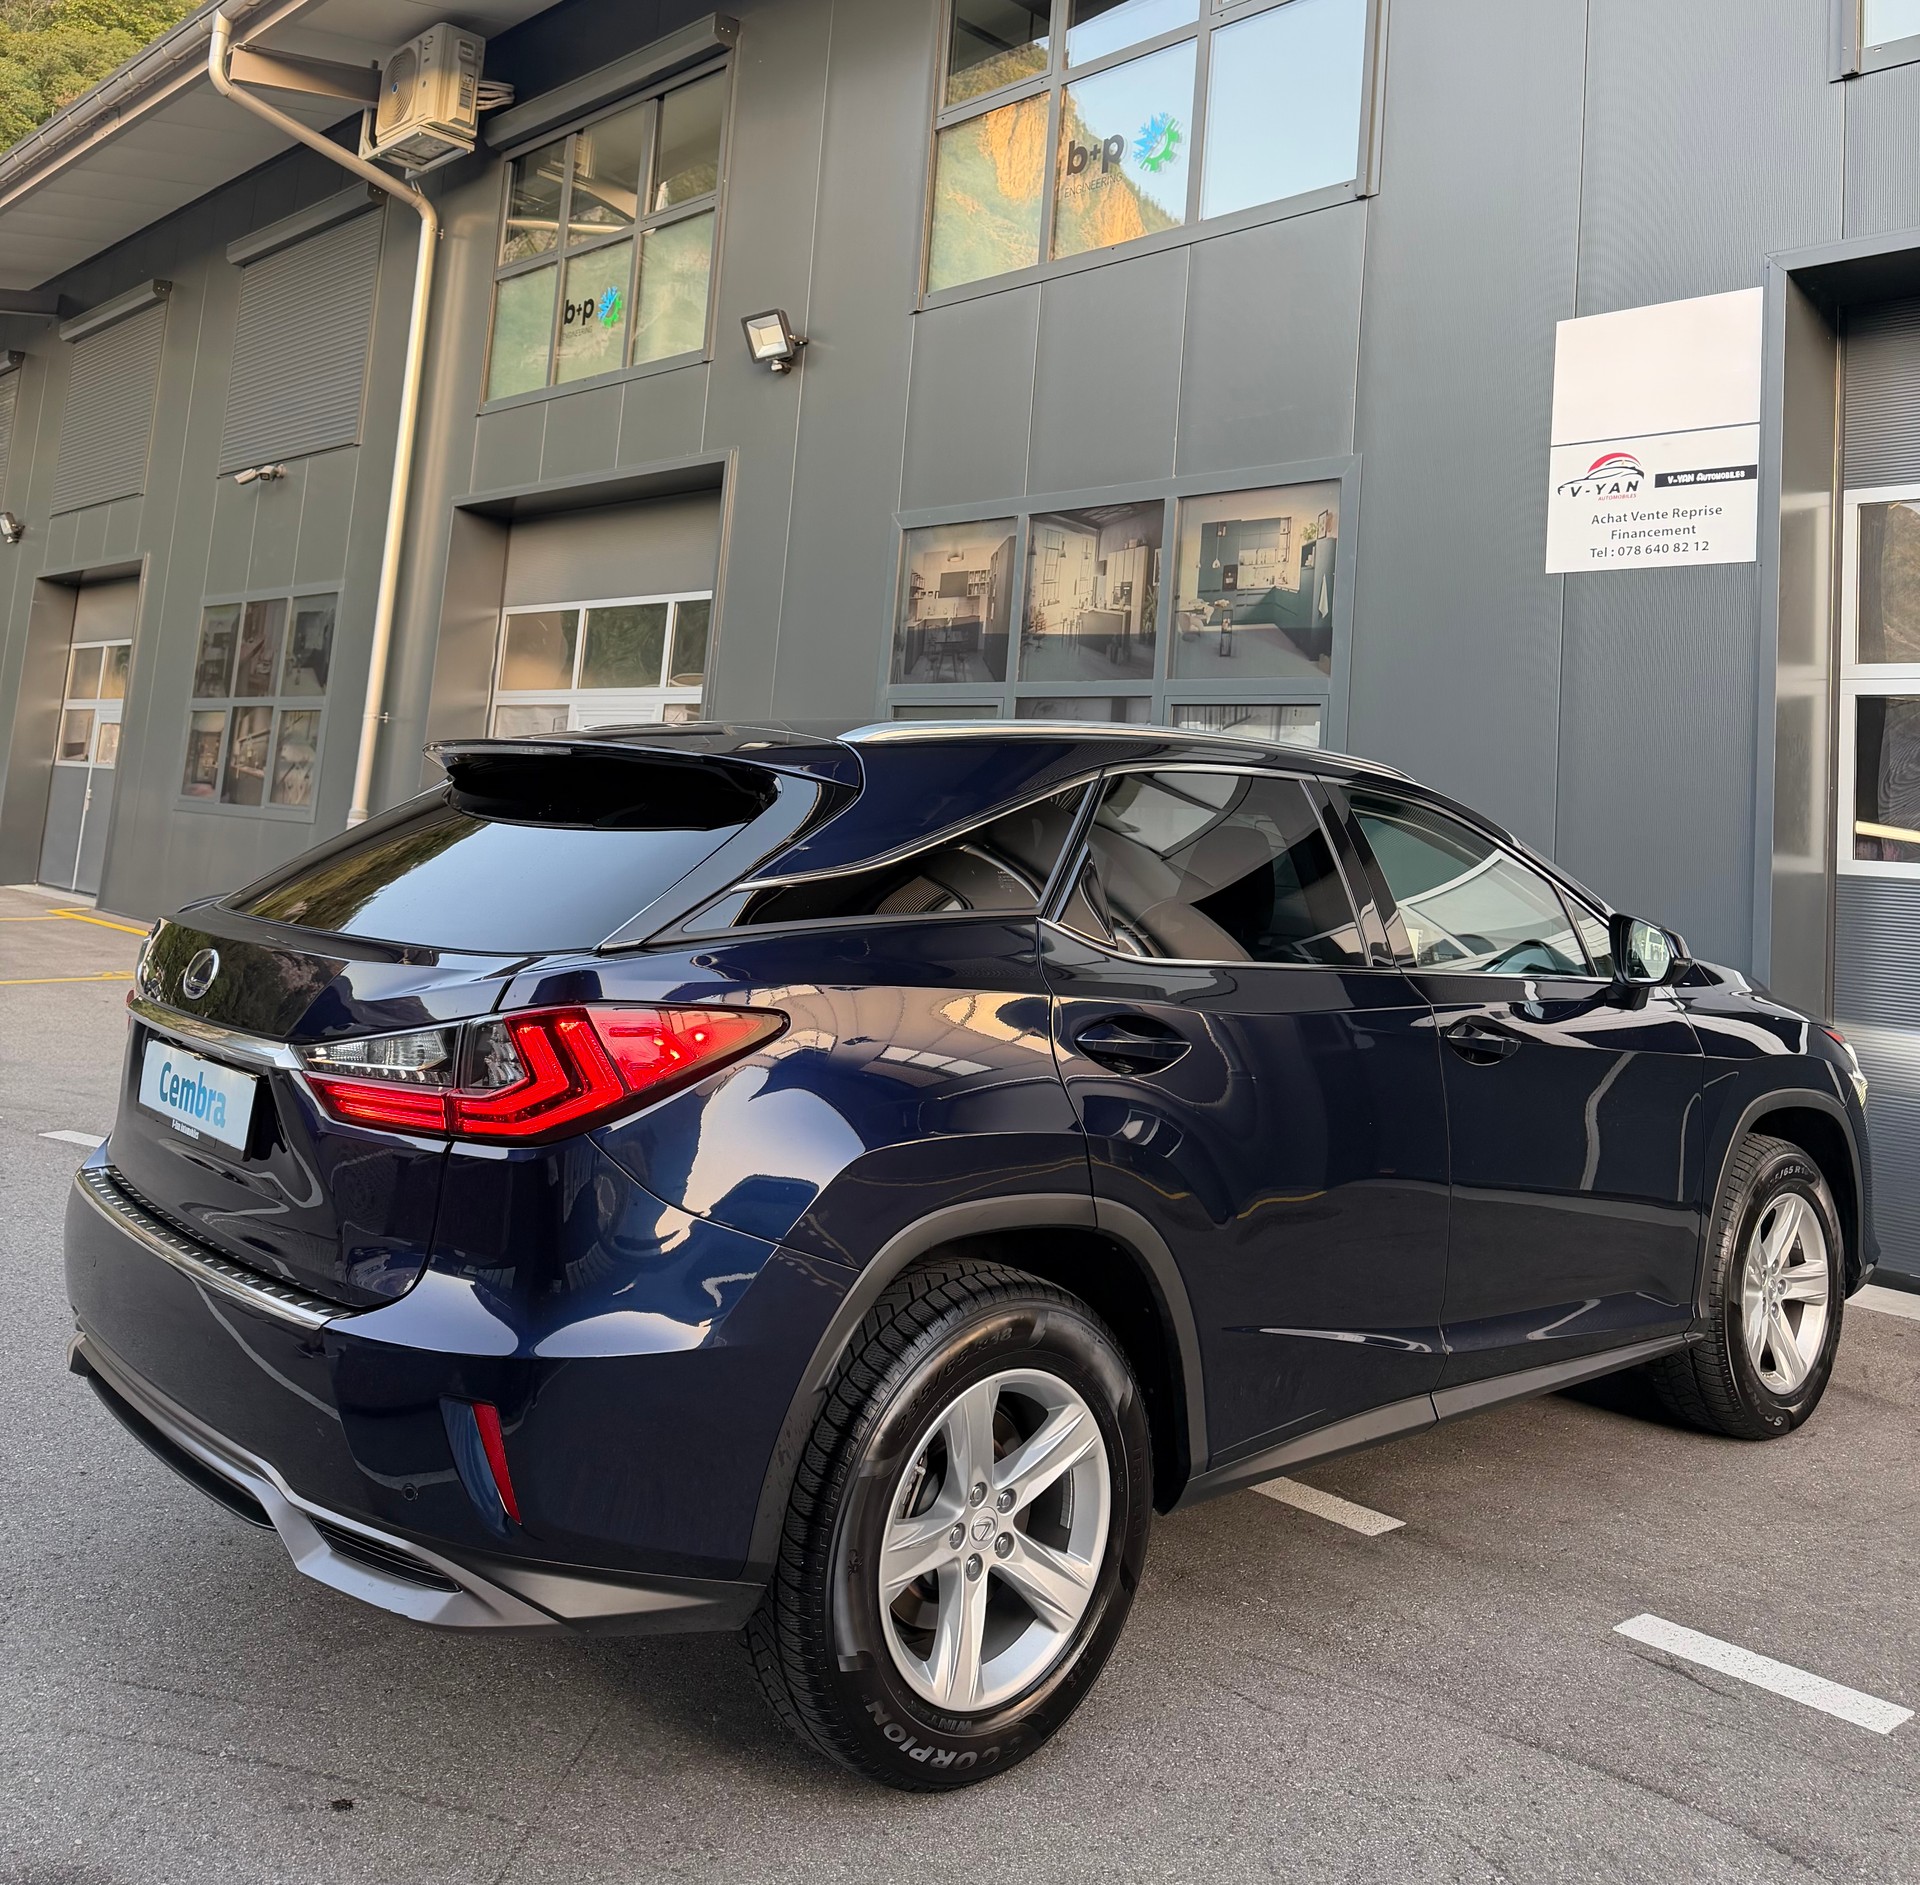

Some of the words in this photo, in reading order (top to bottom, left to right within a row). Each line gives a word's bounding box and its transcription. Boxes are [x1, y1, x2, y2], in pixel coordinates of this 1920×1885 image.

[1067, 134, 1125, 176] b+p
[1064, 172, 1123, 198] ENGINEERING
[563, 298, 595, 325] b+p
[1597, 493, 1638, 501] AUTOMOBILES
[1591, 513, 1628, 525] Achat
[1630, 510, 1669, 522] Vente
[1672, 505, 1723, 520] Reprise
[1611, 525, 1697, 540] Financement
[1617, 545, 1641, 556] 078
[1645, 543, 1669, 555] 640
[1673, 542, 1689, 552] 82
[1694, 541, 1709, 552] 12
[160, 1061, 227, 1129] Cembra
